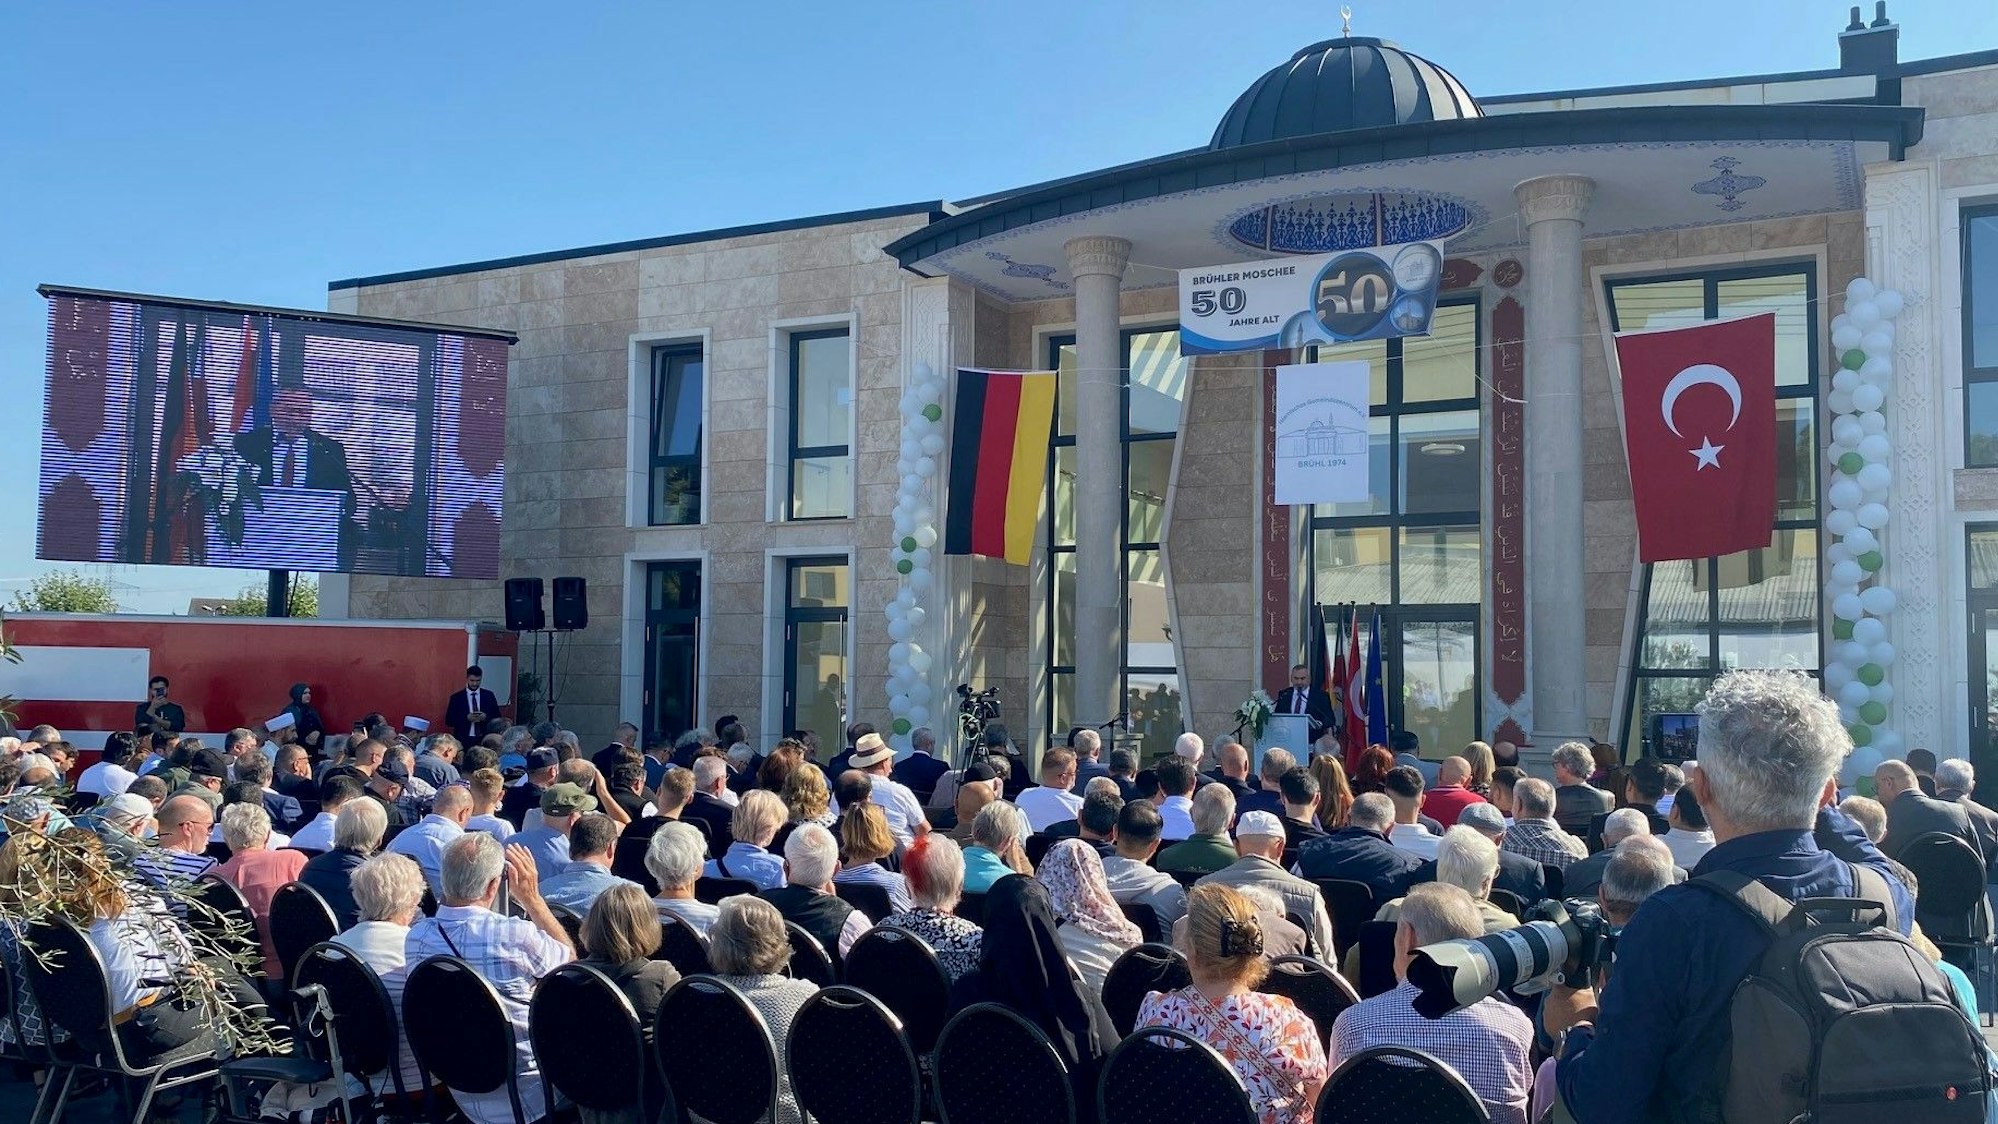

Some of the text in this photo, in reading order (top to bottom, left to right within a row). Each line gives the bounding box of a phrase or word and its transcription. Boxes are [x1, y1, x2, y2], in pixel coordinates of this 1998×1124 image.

[1193, 265, 1296, 286] BRÜHLER MOSCHEE
[1191, 286, 1247, 317] 50
[1316, 269, 1389, 321] 50
[1228, 314, 1280, 327] JAHRE ALT
[1298, 458, 1346, 468] BRÜHL 1974
